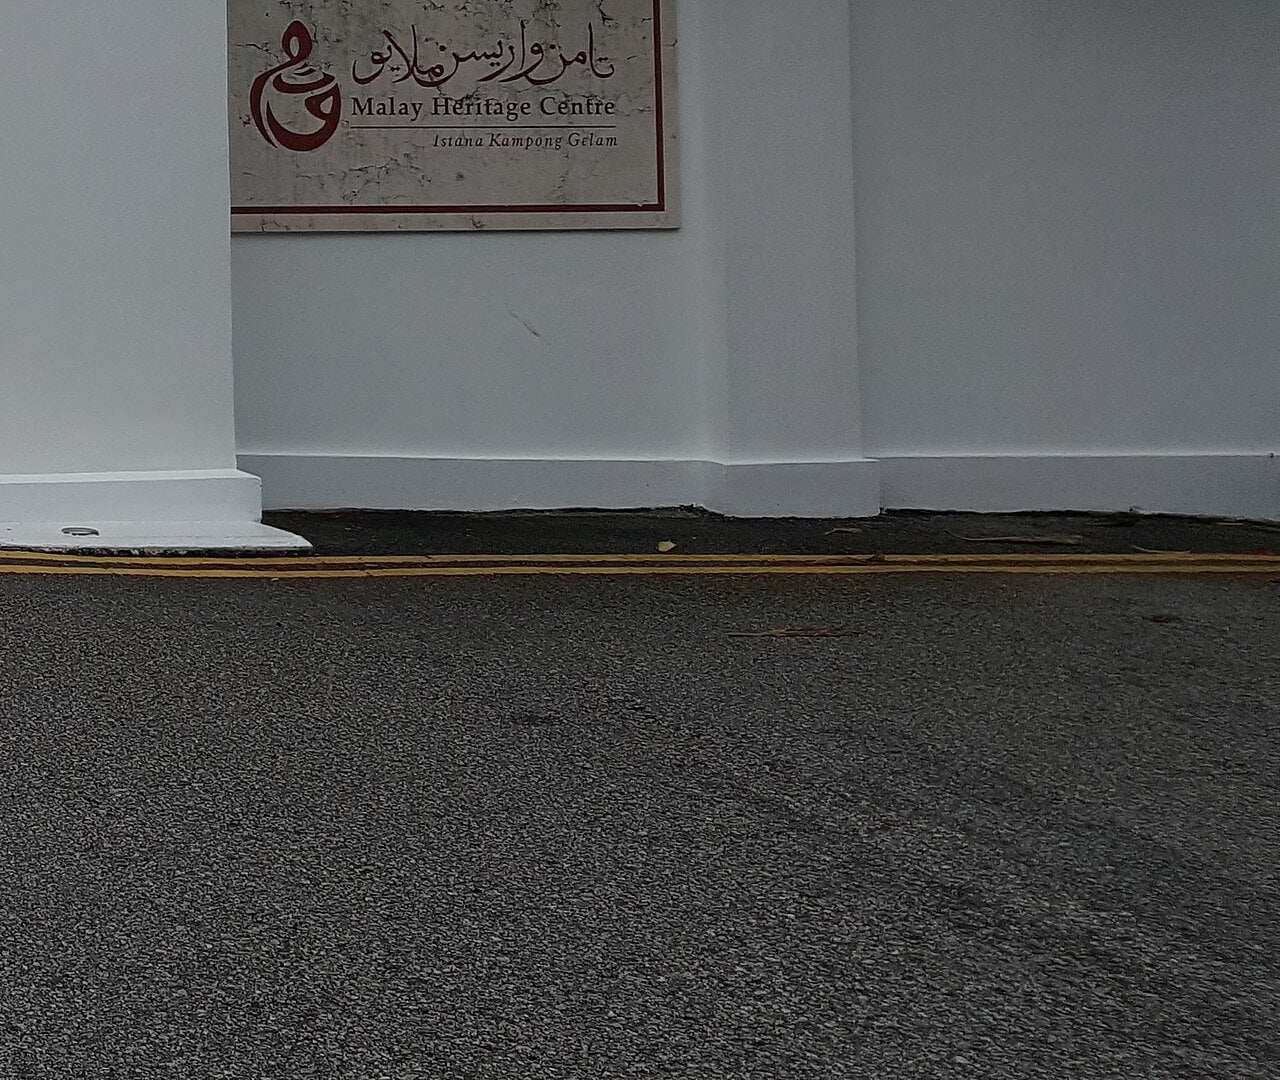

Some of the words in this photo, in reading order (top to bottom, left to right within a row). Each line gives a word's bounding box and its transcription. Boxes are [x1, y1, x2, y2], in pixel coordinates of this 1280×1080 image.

[351, 97, 423, 121] Malay
[431, 97, 531, 121] Heritage
[540, 96, 616, 116] Centre
[433, 133, 484, 148] Istana
[489, 133, 563, 150] Kampong
[568, 132, 618, 147] Gelam
